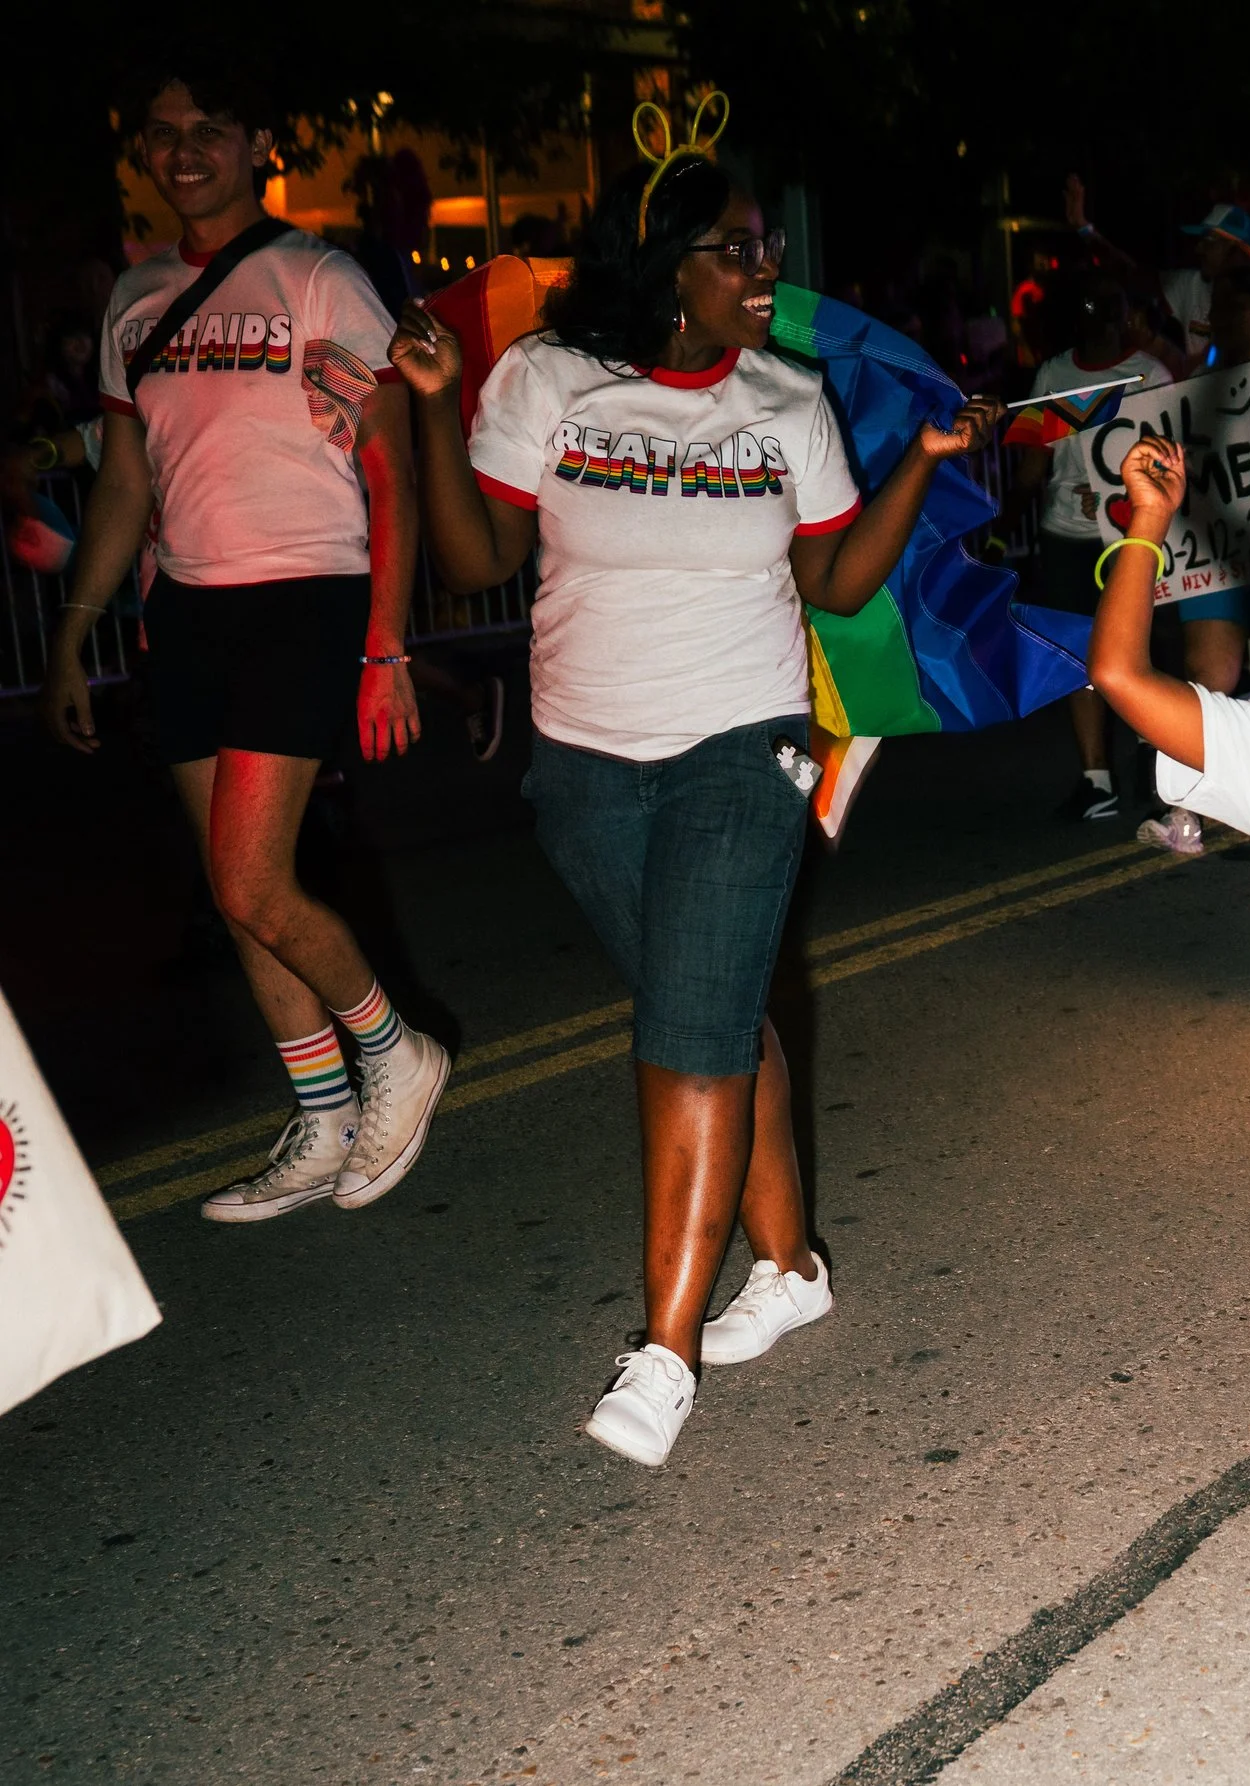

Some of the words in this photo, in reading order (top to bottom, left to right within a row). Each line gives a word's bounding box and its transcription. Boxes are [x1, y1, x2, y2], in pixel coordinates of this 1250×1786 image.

[197, 312, 292, 374] AIDS
[680, 431, 789, 498] AIDS
[1182, 571, 1212, 592] HIV
